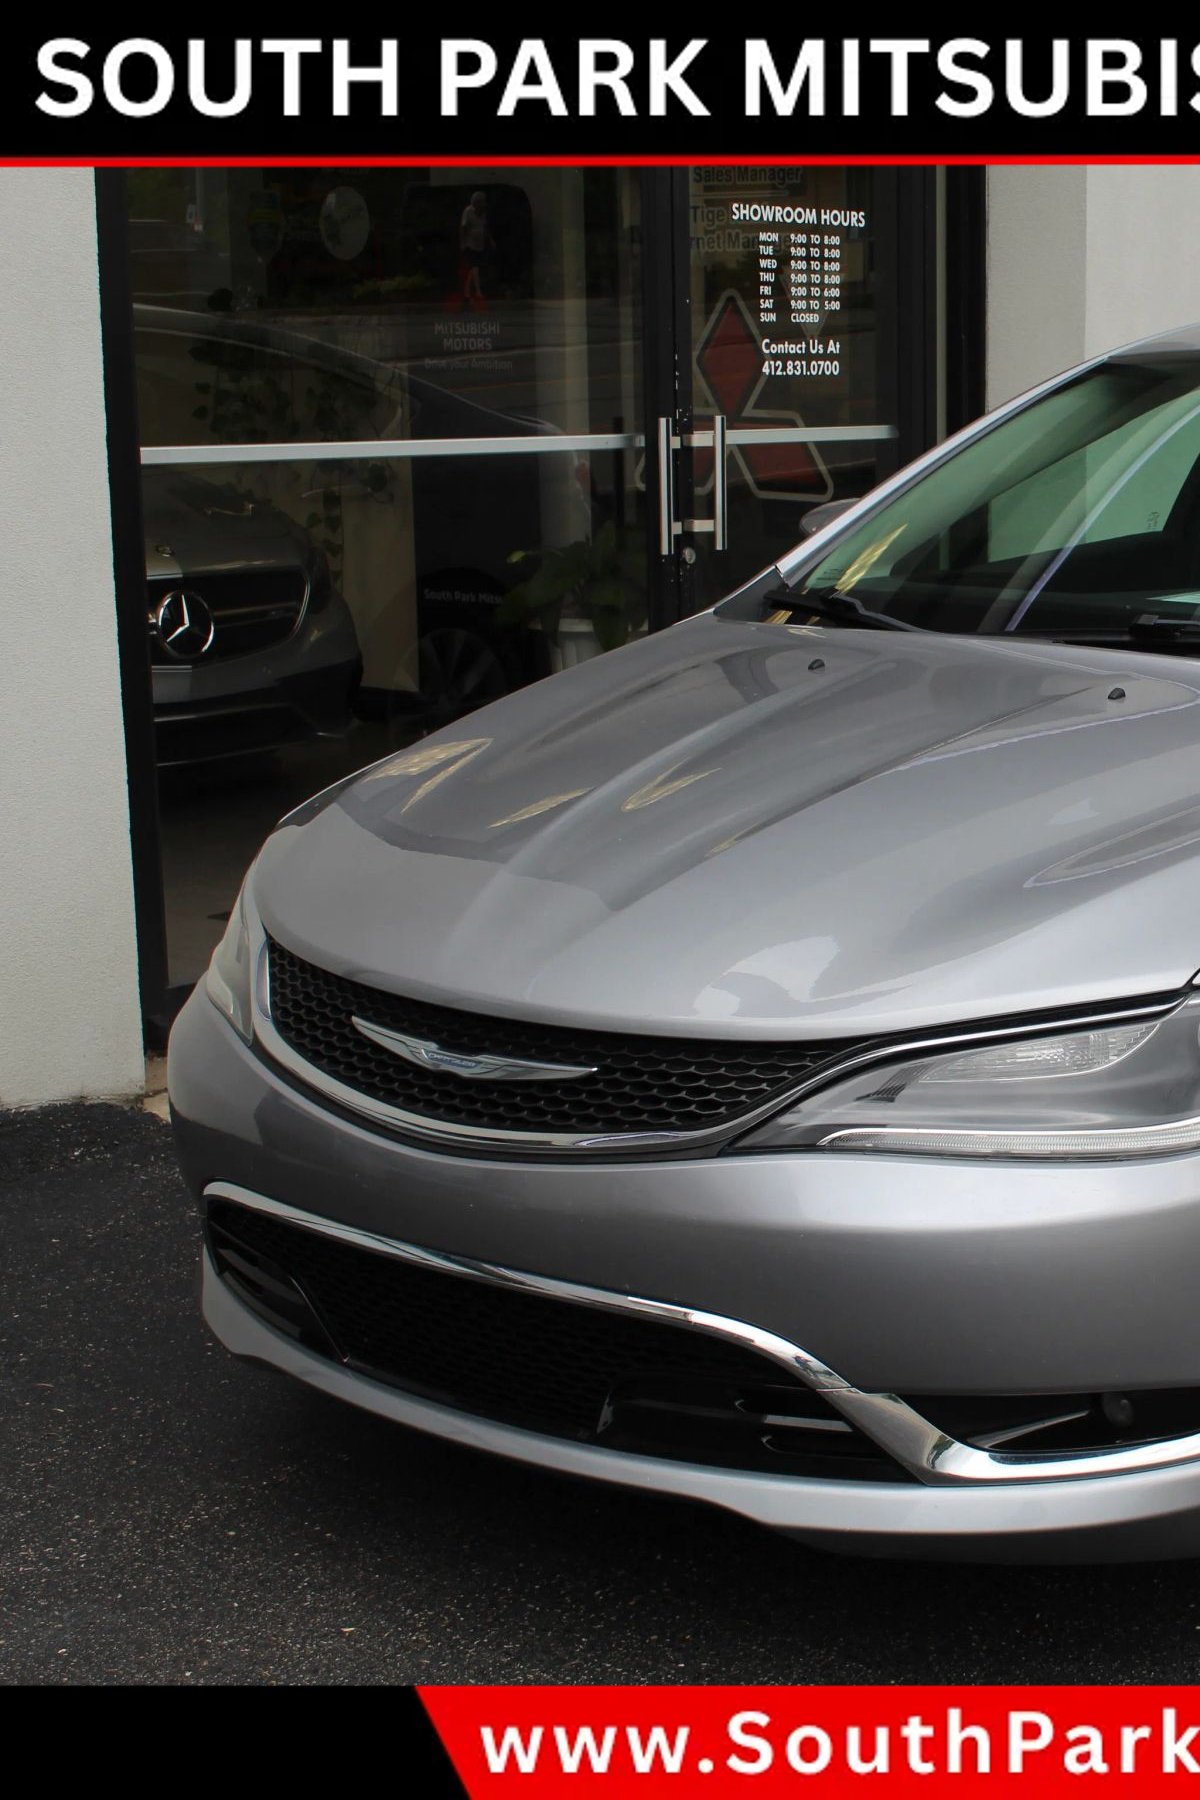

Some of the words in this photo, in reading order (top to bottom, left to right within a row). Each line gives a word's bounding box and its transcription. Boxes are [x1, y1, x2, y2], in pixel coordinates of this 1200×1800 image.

[694, 166, 733, 184] Sales
[731, 203, 817, 224] SHOWROOM
[820, 208, 866, 227] HOURS
[759, 232, 779, 242] MON
[790, 234, 807, 244] 9:00
[810, 235, 821, 245] TO
[823, 236, 841, 246] 8:00
[759, 245, 774, 255] TUE
[790, 247, 807, 257] 9:00
[810, 248, 821, 258] TO
[823, 249, 841, 259] 8:00
[759, 259, 778, 269] WED
[790, 260, 807, 270] 9:00
[810, 261, 821, 271] TO
[823, 262, 841, 272] 8:00
[759, 272, 775, 282] THU
[790, 273, 807, 283] 9:00
[810, 274, 821, 284] TO
[823, 275, 841, 285] 8:00
[759, 286, 772, 296] FRI
[790, 287, 807, 297] 9:00
[810, 288, 821, 298] TO
[759, 299, 774, 309] SAT
[790, 300, 807, 310] 9:00
[809, 301, 820, 311] TO
[759, 313, 777, 322] SUN
[790, 313, 820, 323] CLOSED
[434, 321, 500, 335] MITSUBISHI
[443, 338, 493, 352] MOTORS
[761, 338, 806, 354] Contact
[809, 339, 824, 354] Us
[826, 339, 841, 354] At
[761, 360, 840, 376] 412.831.0700
